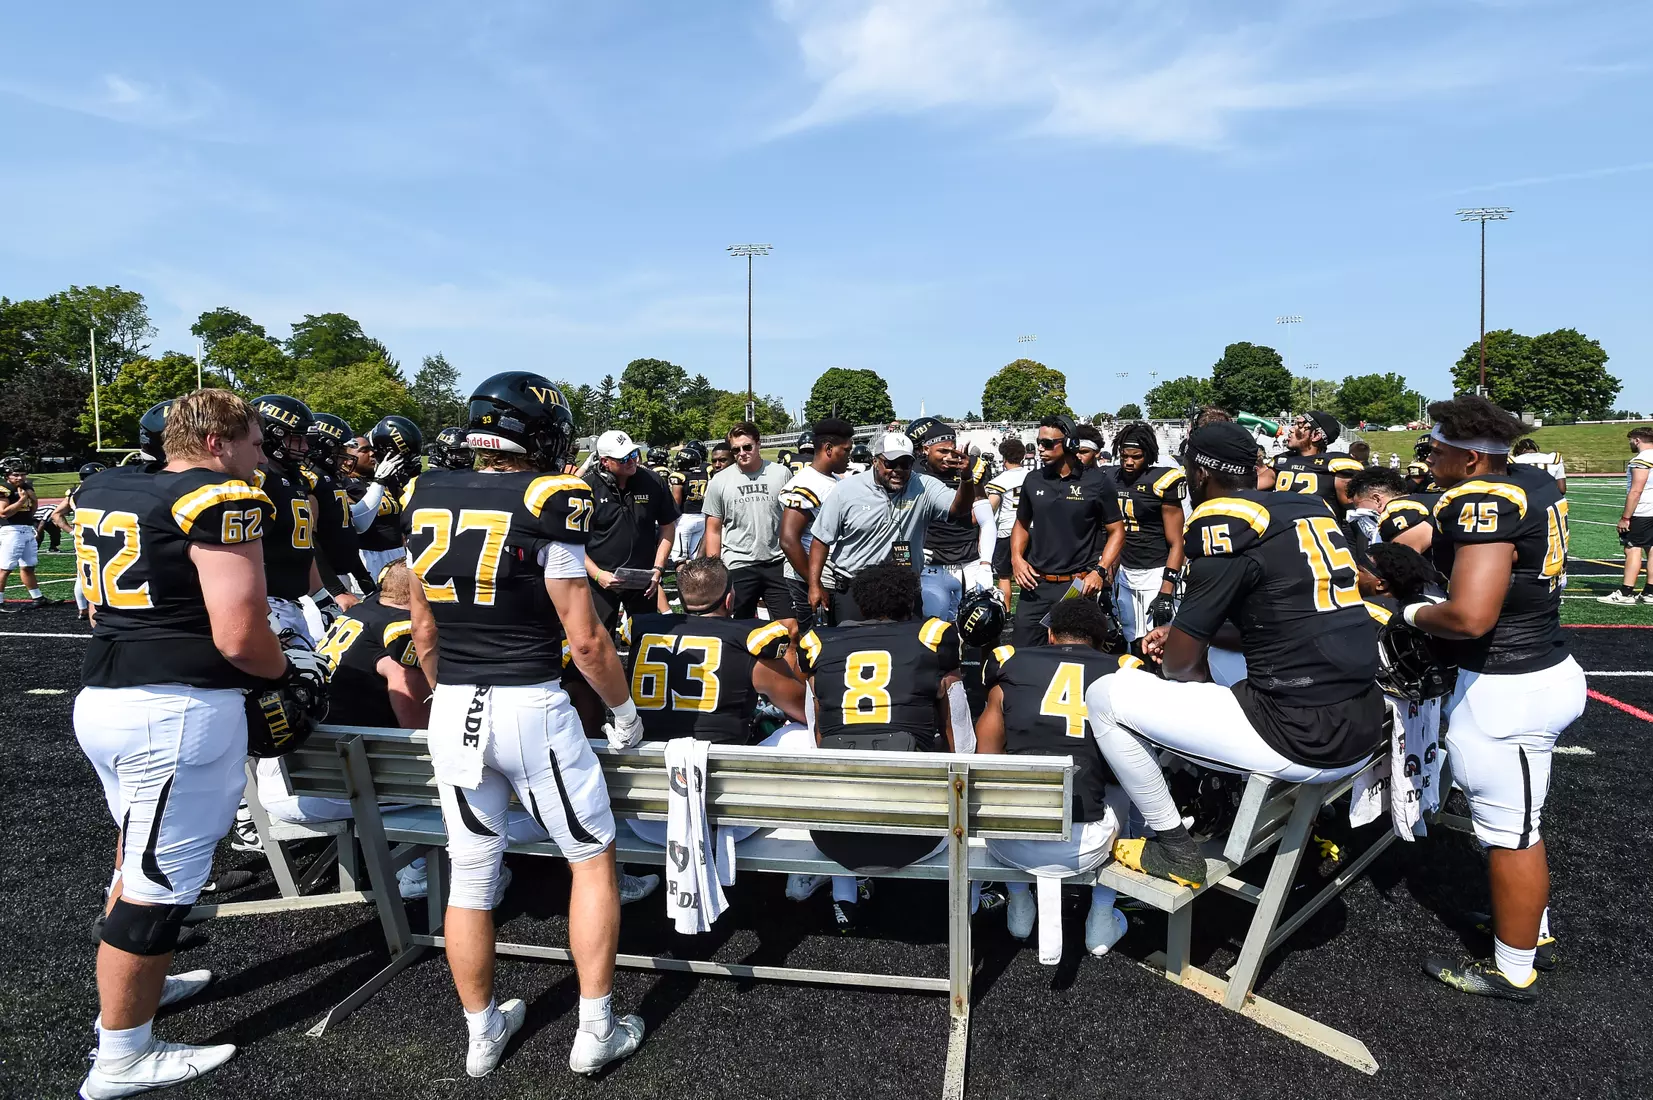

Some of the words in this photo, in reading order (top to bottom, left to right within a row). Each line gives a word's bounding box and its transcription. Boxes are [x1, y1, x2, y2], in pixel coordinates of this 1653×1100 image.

[258, 401, 300, 428] VILLE
[482, 415, 492, 424] 33
[1195, 453, 1220, 470] NIKE
[734, 496, 775, 504] FOOTBALL
[737, 484, 769, 496] VILLE
[221, 507, 264, 544] 62
[565, 497, 594, 533] 27
[1458, 501, 1498, 533] 45
[72, 507, 154, 609] 62
[405, 508, 513, 606] 27
[1201, 523, 1233, 557] 15
[1293, 516, 1364, 612] 15
[963, 606, 988, 633] VILLE
[630, 633, 722, 713] 63
[842, 650, 892, 725] 8
[463, 684, 491, 751] RADE
[1040, 662, 1089, 738] 4
